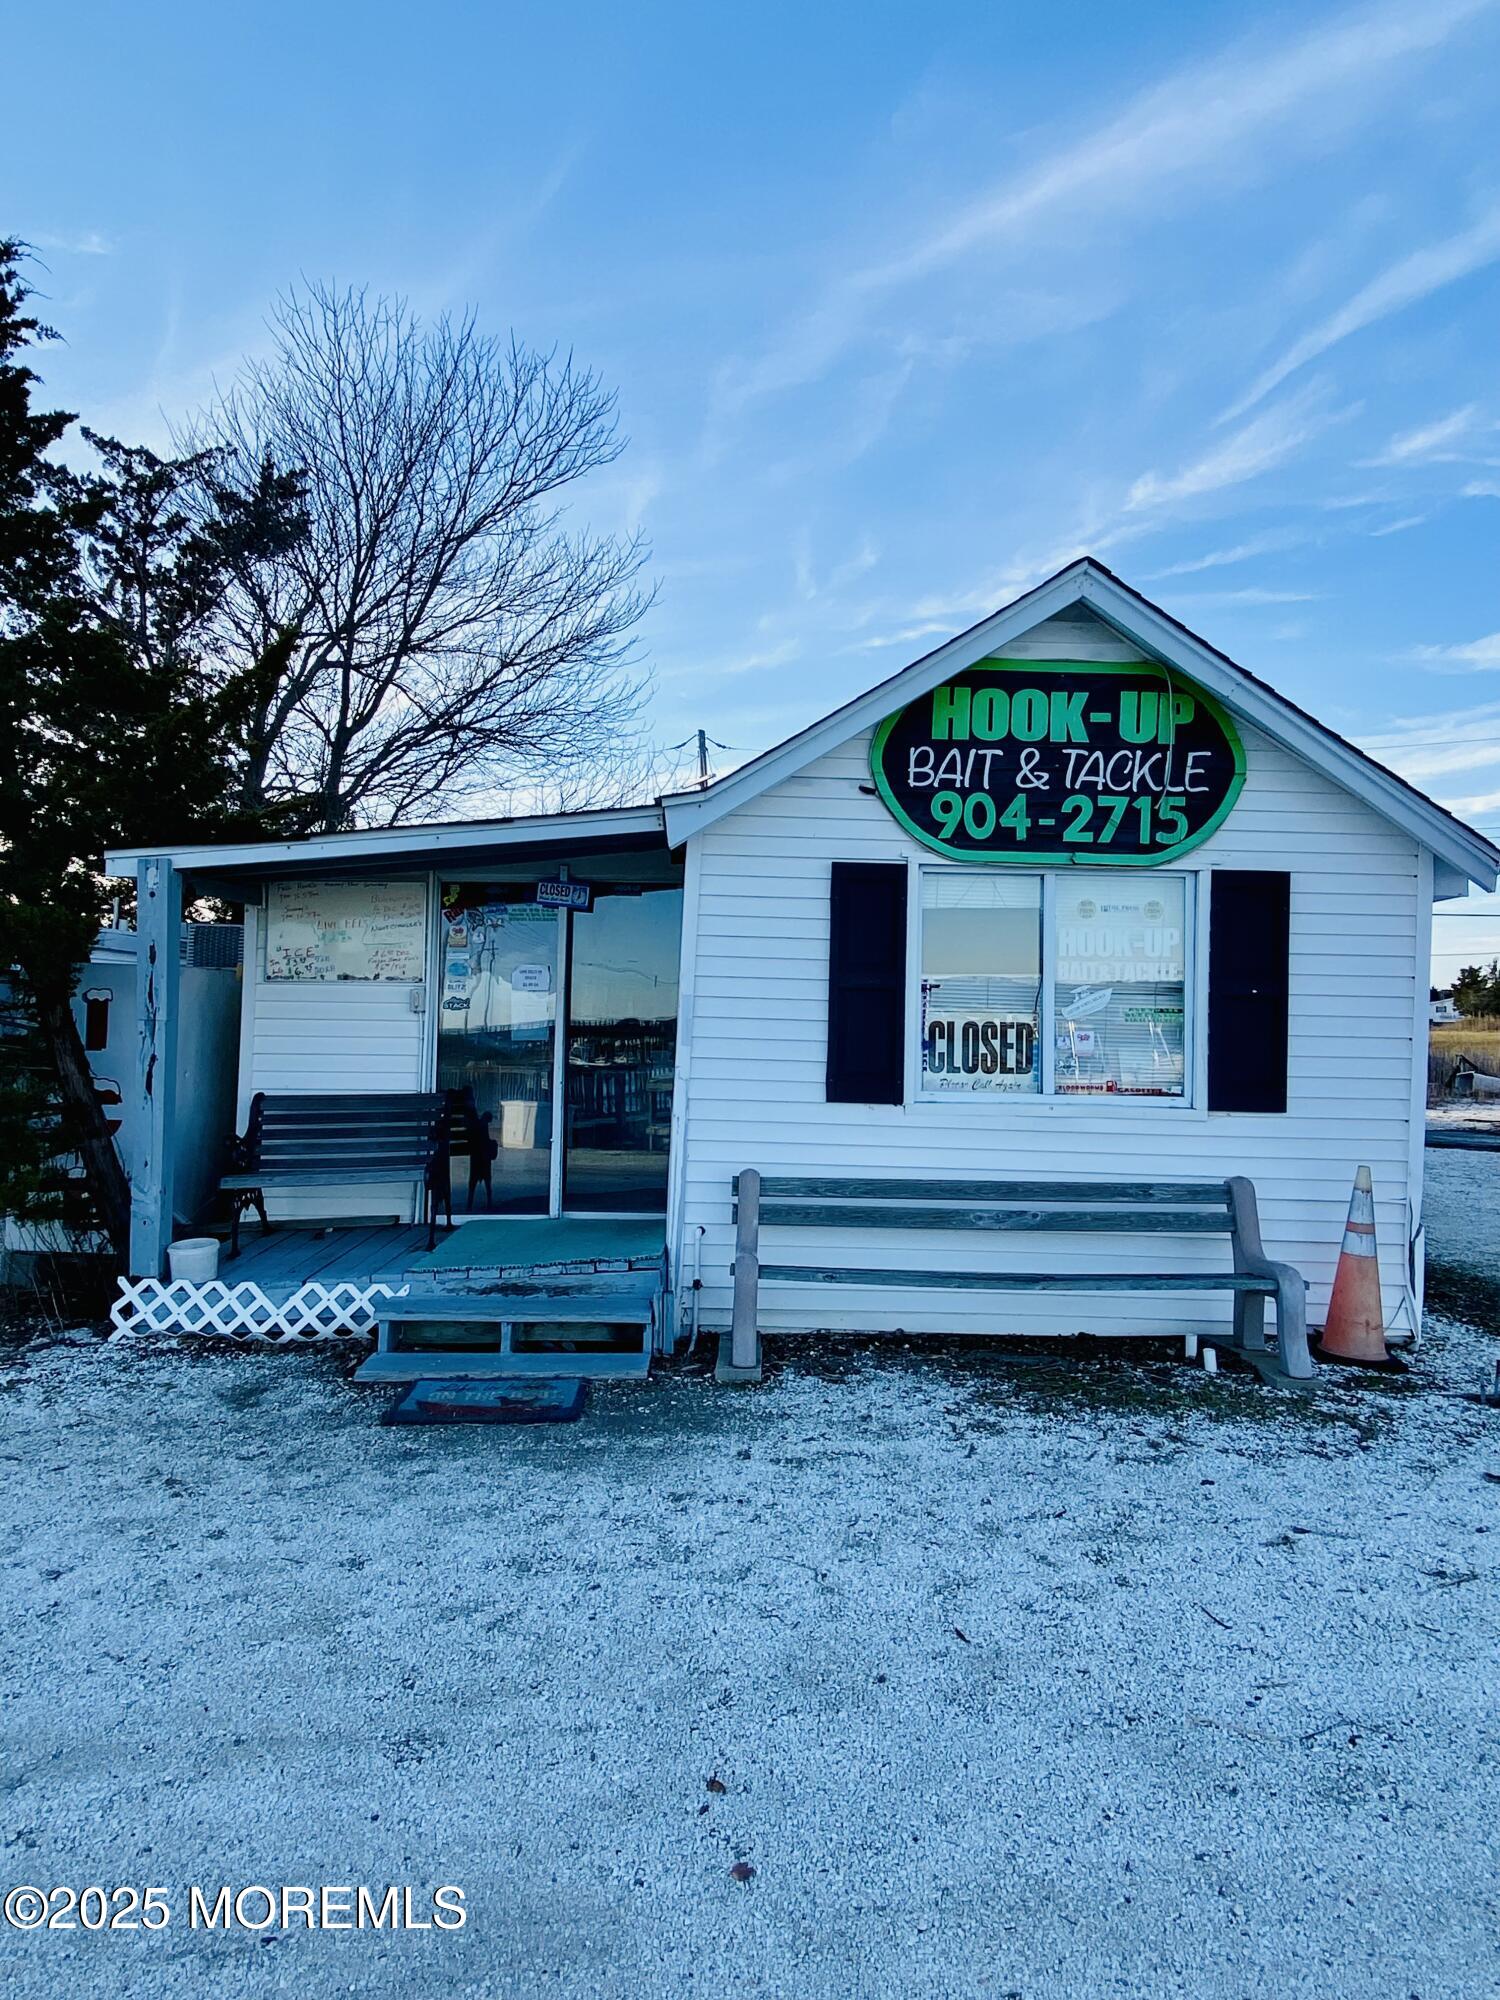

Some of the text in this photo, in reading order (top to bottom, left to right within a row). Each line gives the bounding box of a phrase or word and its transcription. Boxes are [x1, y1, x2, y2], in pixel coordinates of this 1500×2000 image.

[931, 687, 1195, 745] HOOK-UP
[908, 746, 1212, 793] BAIT & TACKLE
[930, 791, 1189, 845] 904-2715
[540, 883, 571, 898] CLOSED
[1059, 927, 1180, 958] HOOK-UP
[928, 1020, 1034, 1075] CLOSED
[971, 1079, 993, 1091] Call
[995, 1080, 1022, 1092] Again
